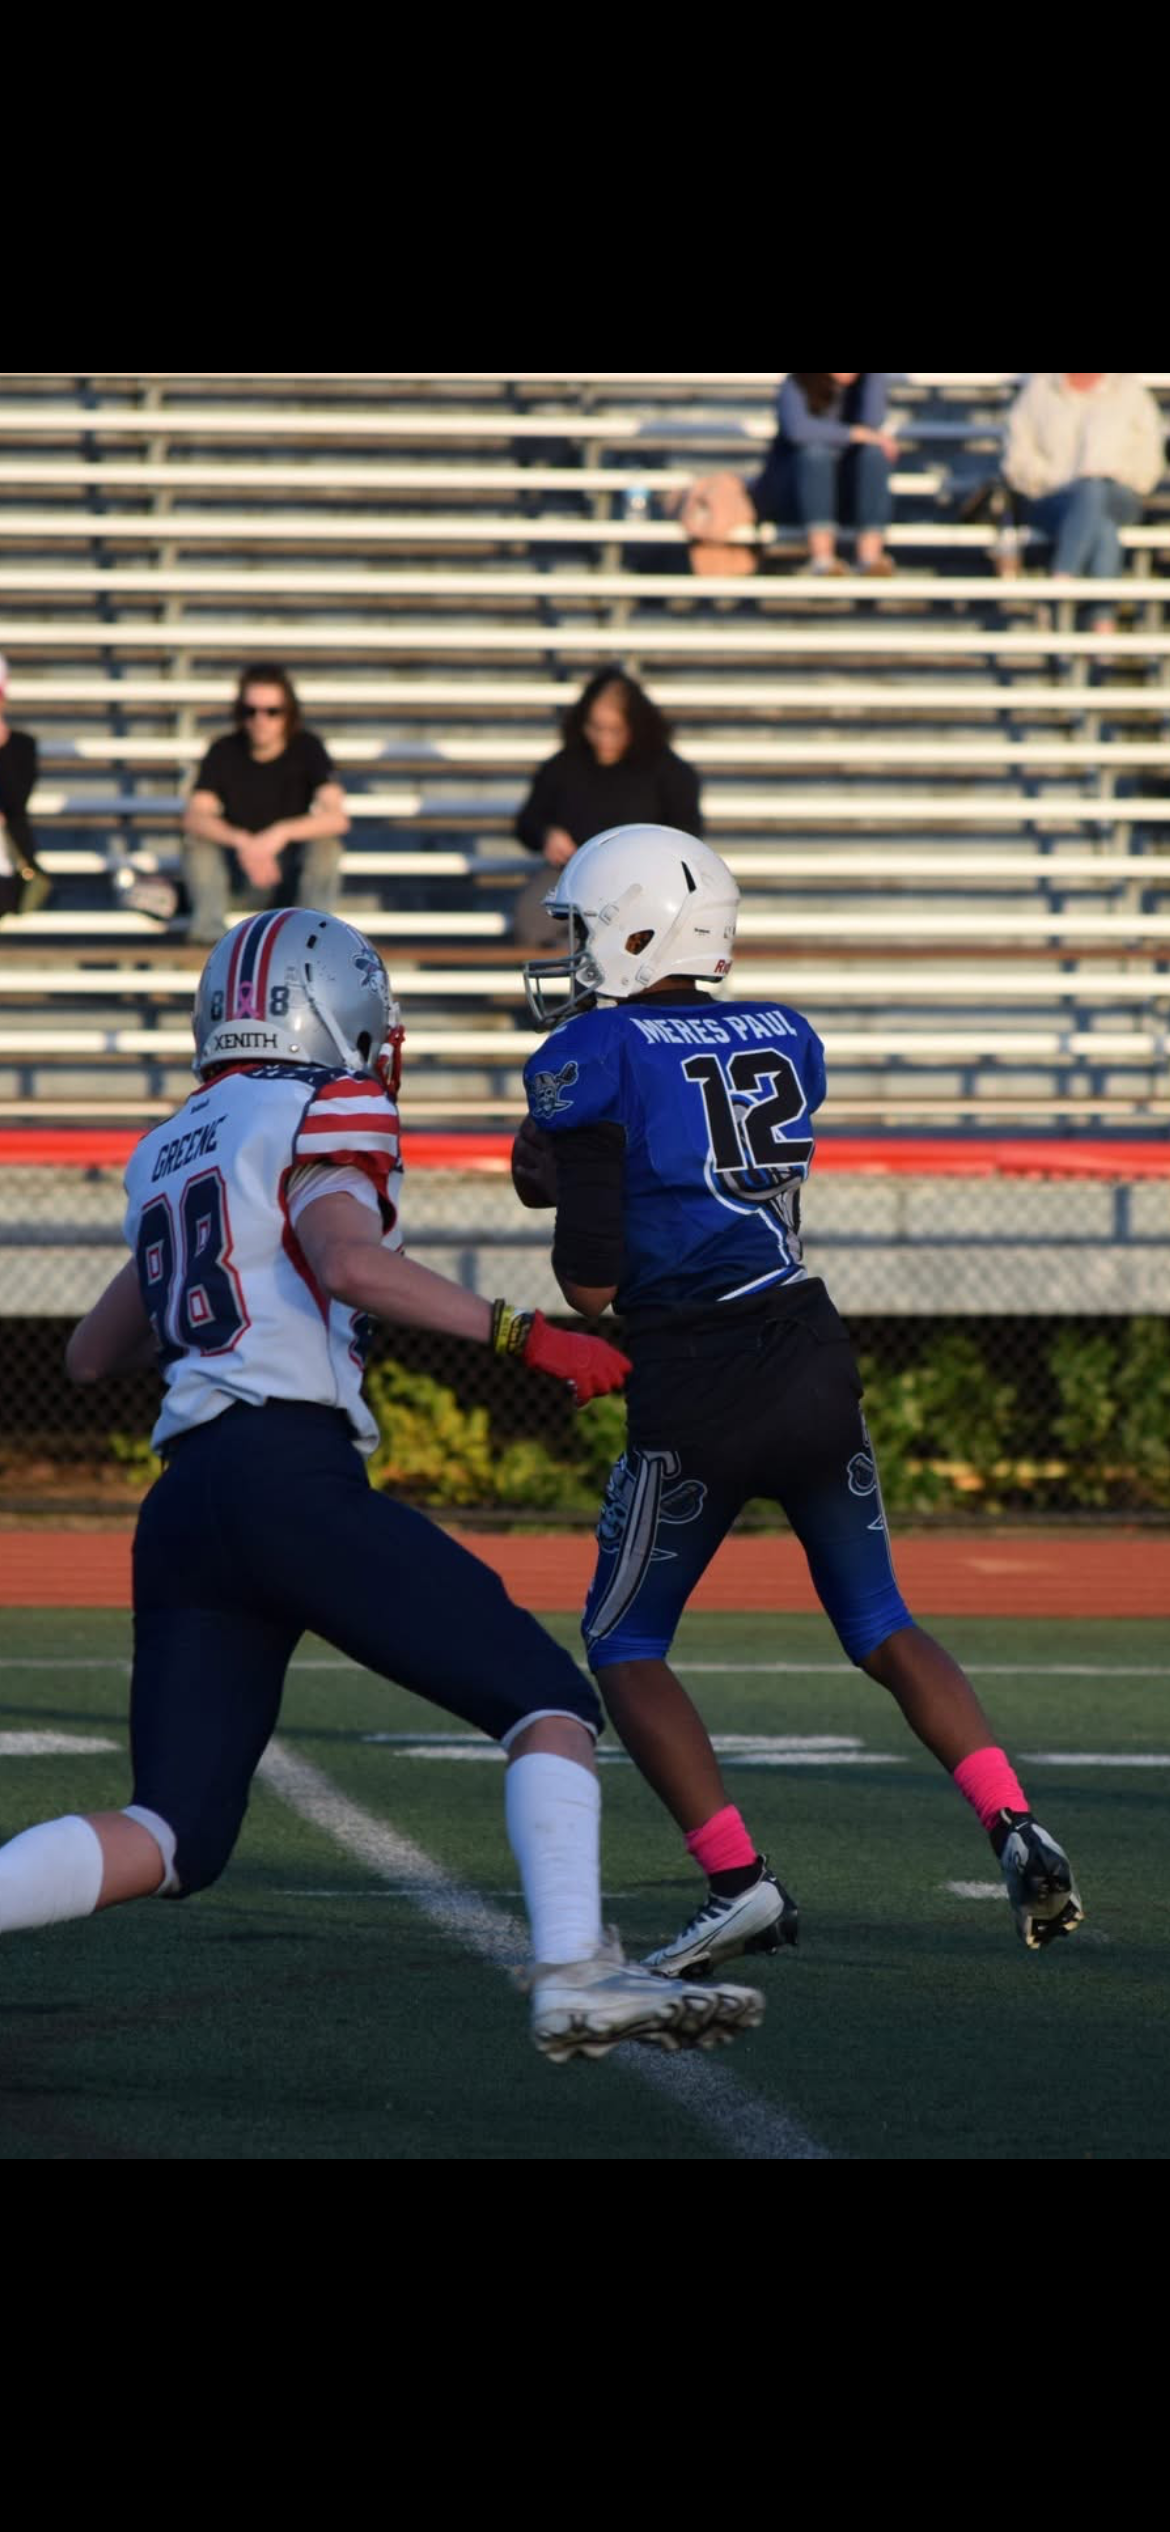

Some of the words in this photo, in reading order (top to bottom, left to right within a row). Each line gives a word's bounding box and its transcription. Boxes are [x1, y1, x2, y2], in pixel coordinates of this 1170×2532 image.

[211, 990, 224, 1022] 8
[269, 985, 290, 1017] 8
[213, 1031, 279, 1052] XENITH
[629, 1017, 731, 1045] MERES
[723, 1010, 798, 1041] PAUL
[680, 1047, 815, 1174] 12
[151, 1113, 229, 1184] GREENE
